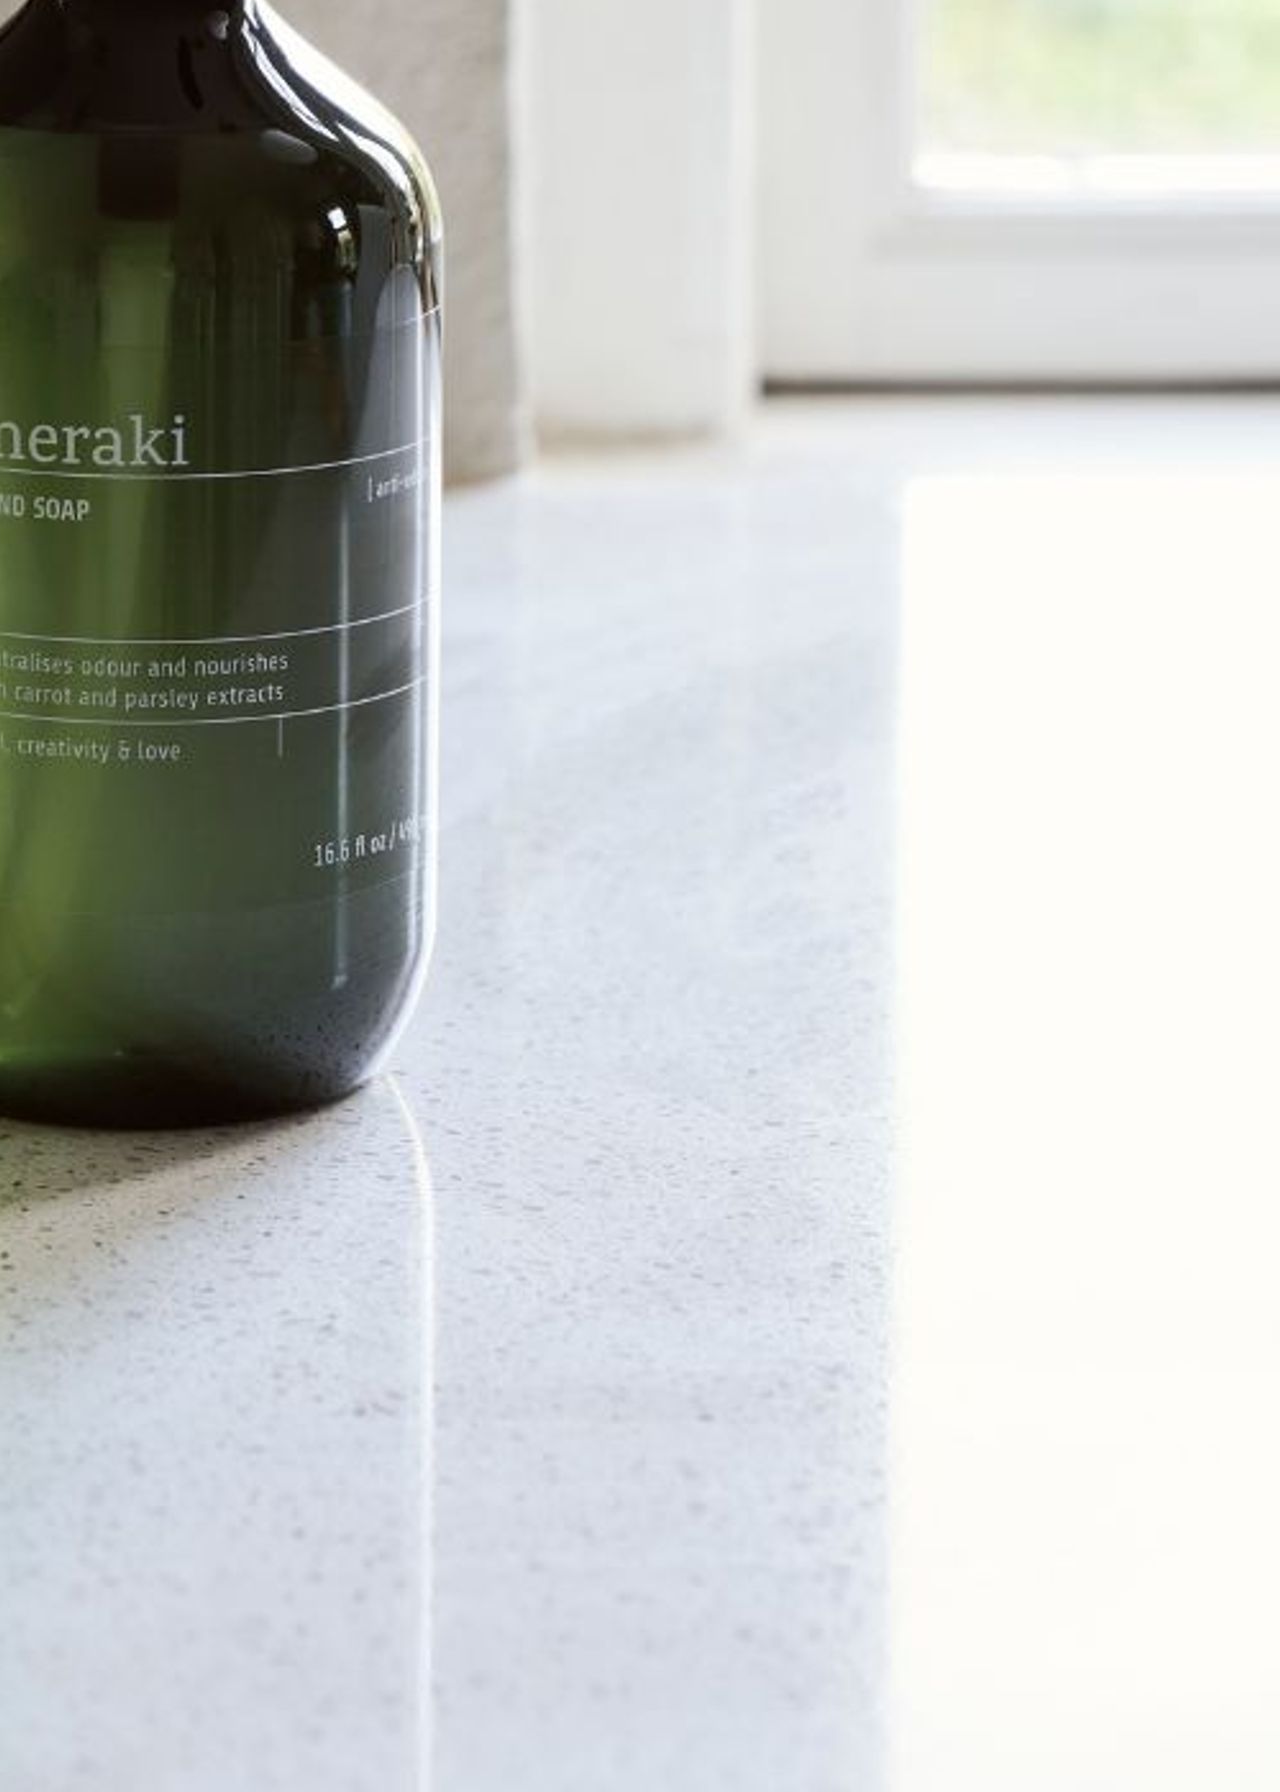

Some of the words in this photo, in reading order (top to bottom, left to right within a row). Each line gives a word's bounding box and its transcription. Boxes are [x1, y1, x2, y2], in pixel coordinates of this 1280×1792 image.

[33, 495, 91, 521] SOAP
[81, 659, 141, 677] odour
[148, 657, 186, 677] and
[194, 653, 288, 676] nourishes
[15, 685, 71, 705] carrot
[79, 688, 117, 708] and
[125, 689, 198, 713] parsley
[207, 684, 284, 706] extracts
[17, 738, 110, 764] creativity
[118, 740, 131, 760] &
[138, 740, 181, 760] love
[314, 839, 349, 867] 16.6
[355, 834, 366, 858] fl
[370, 834, 387, 854] oz
